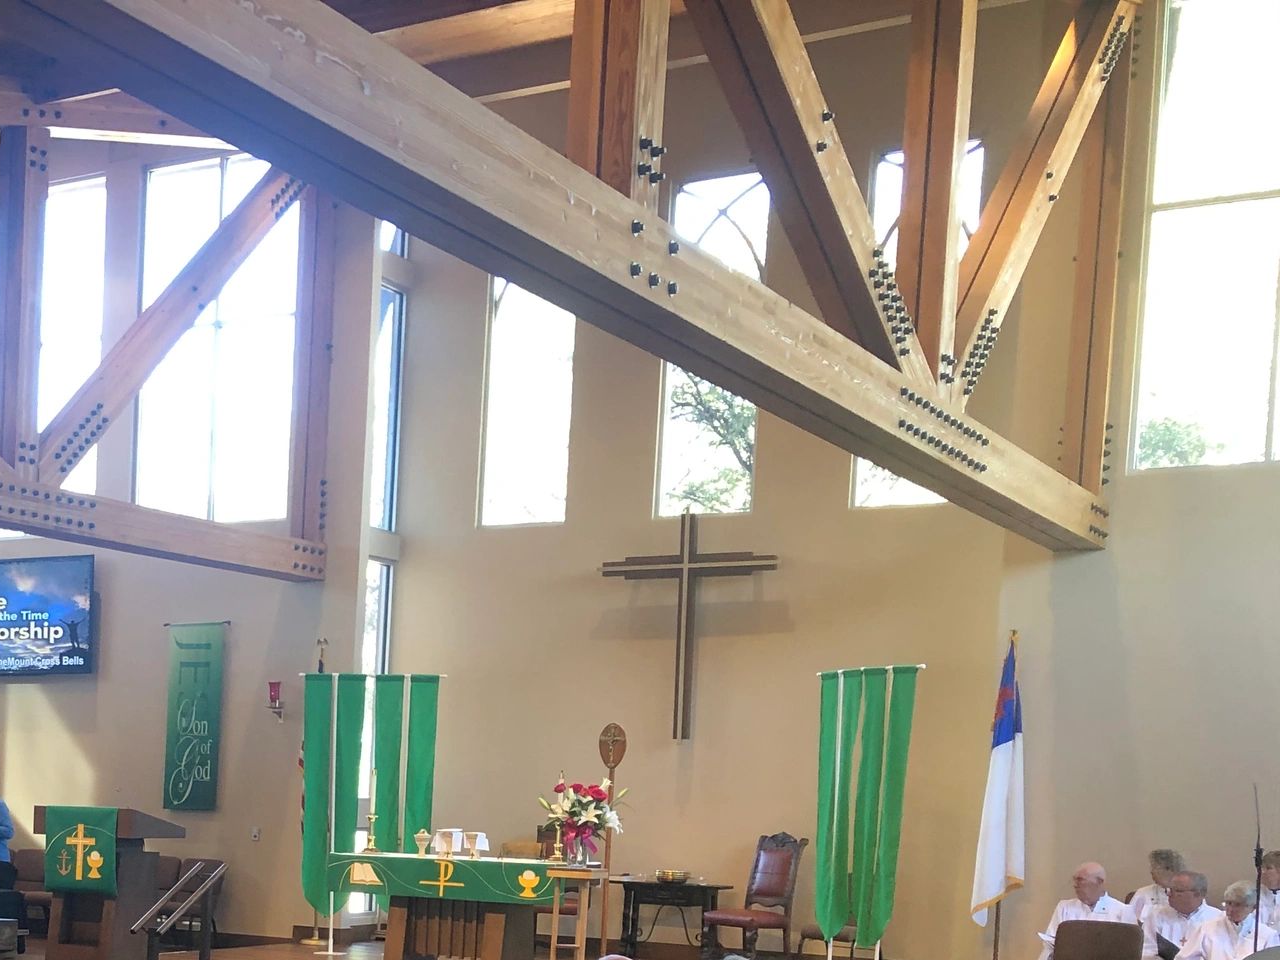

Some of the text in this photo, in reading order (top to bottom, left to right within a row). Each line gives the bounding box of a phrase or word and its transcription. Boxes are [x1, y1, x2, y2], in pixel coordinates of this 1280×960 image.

[20, 610, 49, 621] Time
[35, 656, 60, 666] Cross
[62, 656, 84, 666] Bells
[177, 693, 208, 735] Son
[200, 740, 212, 754] of
[169, 736, 211, 805] God
